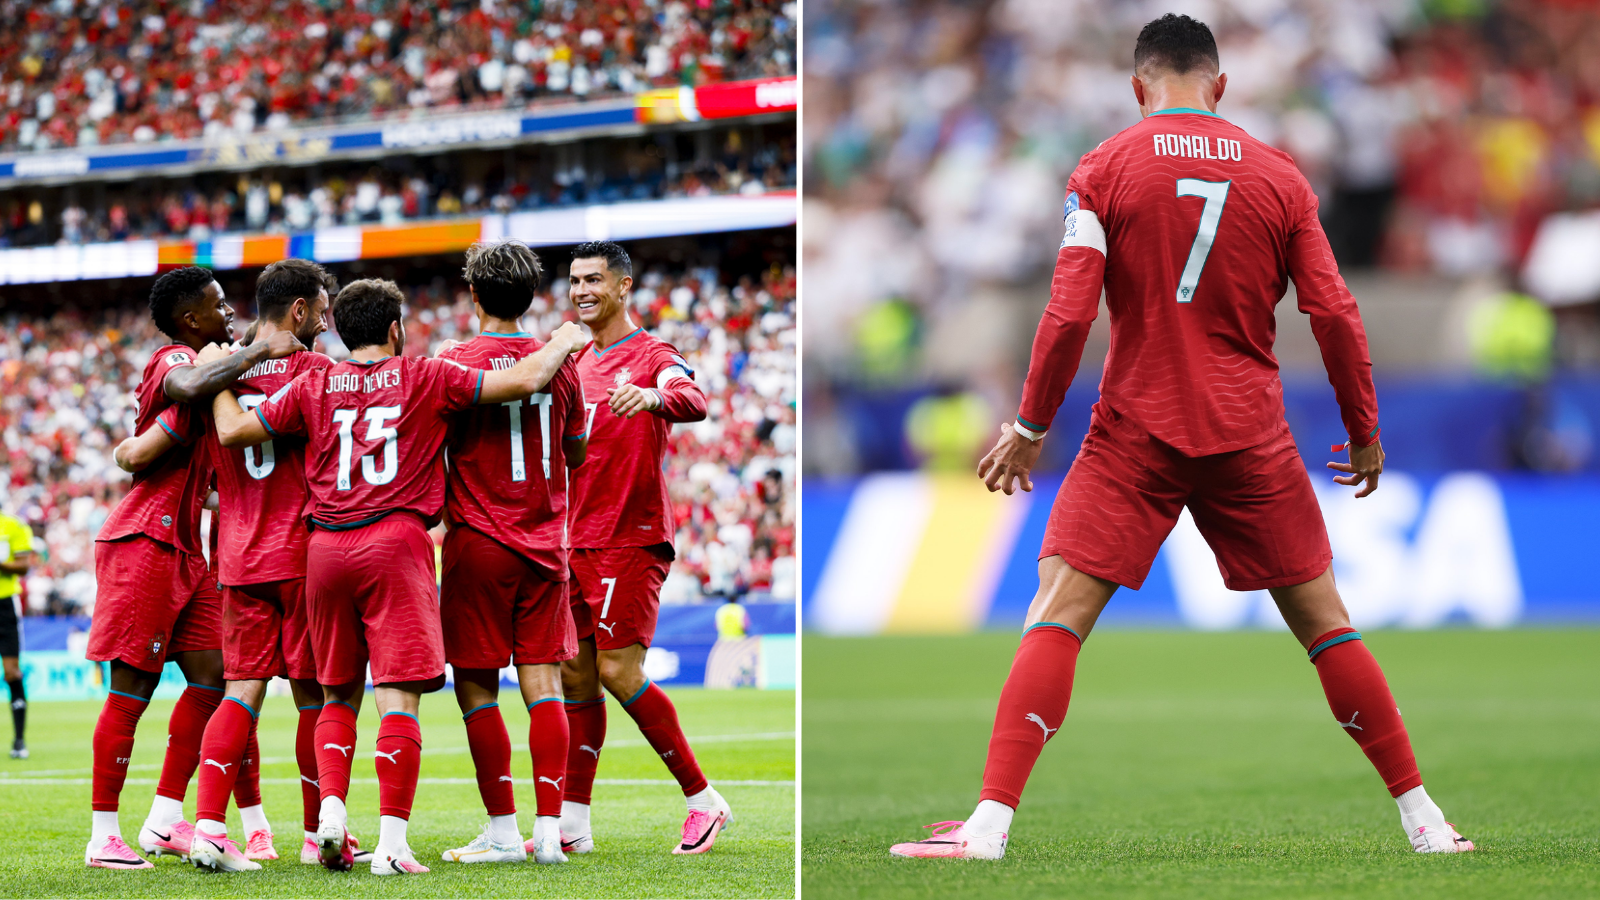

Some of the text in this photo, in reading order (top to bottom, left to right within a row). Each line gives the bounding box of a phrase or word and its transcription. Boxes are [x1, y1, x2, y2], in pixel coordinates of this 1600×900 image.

[1153, 133, 1242, 162] RONALDO
[1175, 177, 1232, 304] 7
[326, 368, 400, 394] JOÃO NEVES
[332, 403, 402, 491] 15
[501, 392, 553, 482] 11
[1160, 468, 1526, 630] VSA
[601, 577, 617, 619] 7
